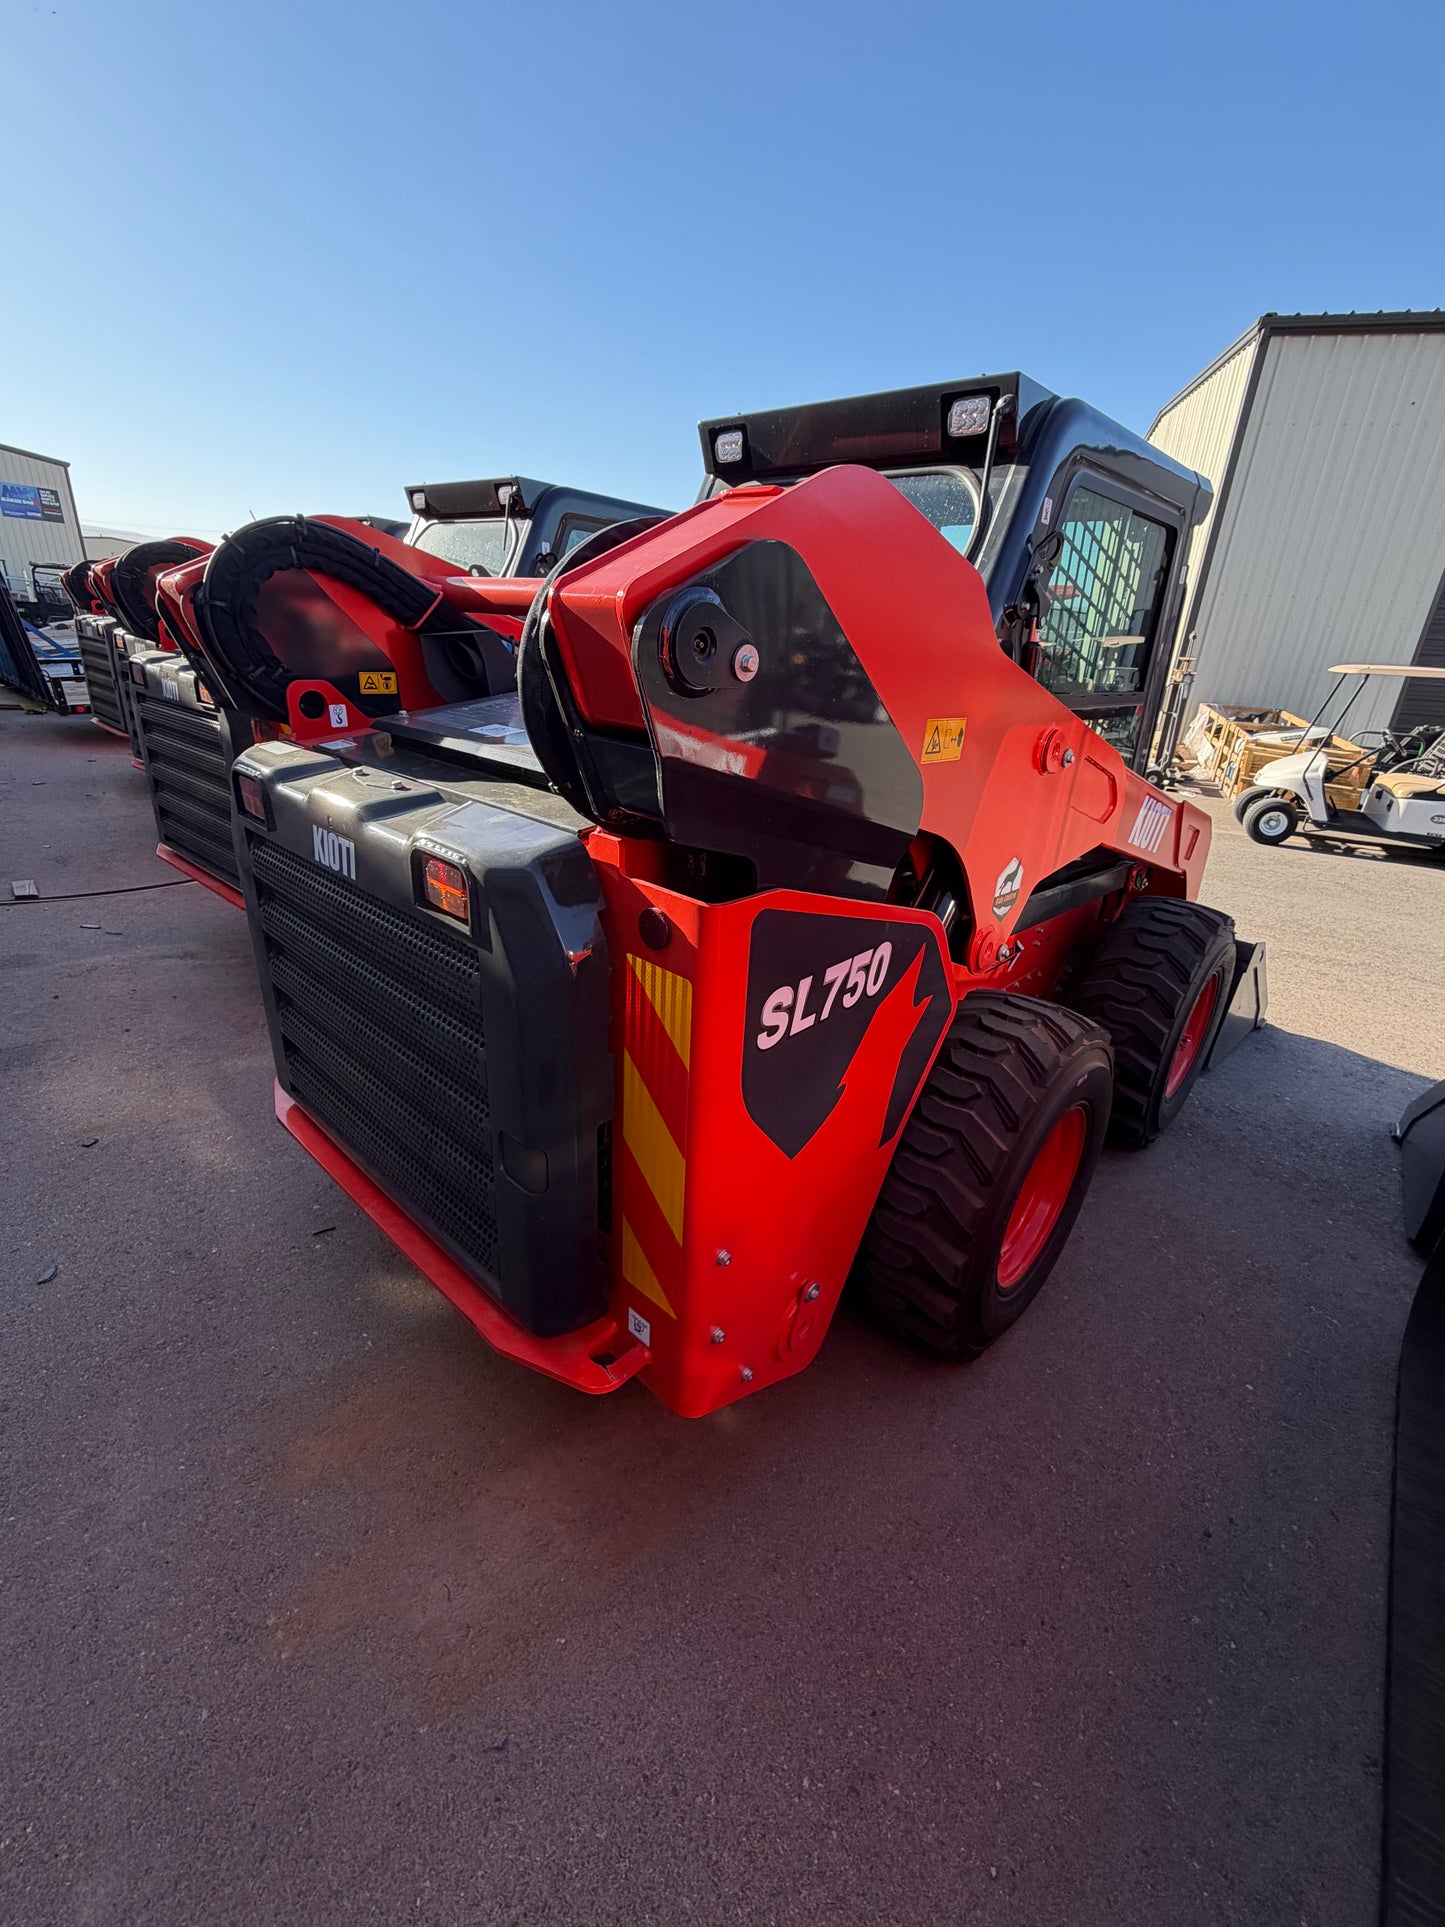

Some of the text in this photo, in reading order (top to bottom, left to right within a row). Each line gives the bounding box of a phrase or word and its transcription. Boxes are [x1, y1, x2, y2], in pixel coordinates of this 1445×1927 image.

[313, 824, 356, 880] KIOTI
[1128, 795, 1172, 853] KIOTI
[757, 941, 893, 1050] SL750
